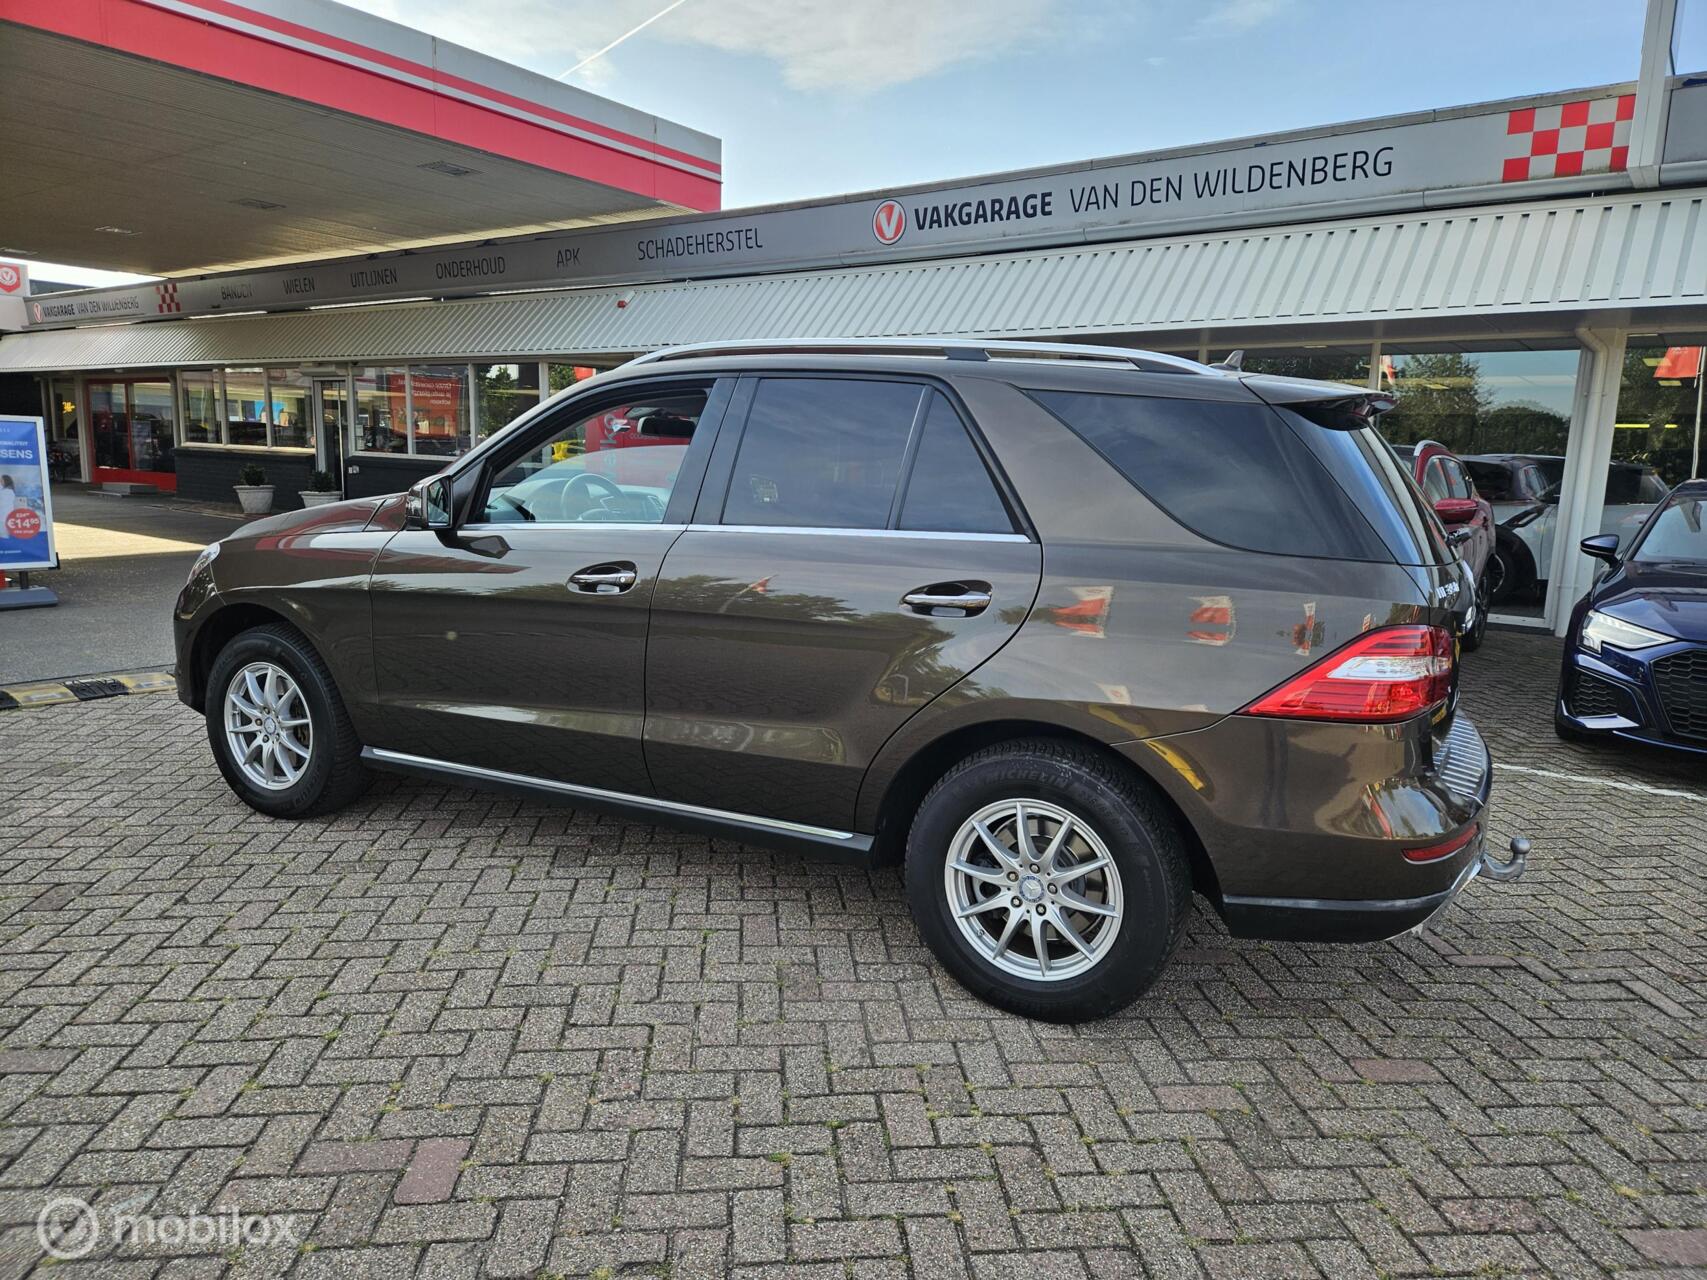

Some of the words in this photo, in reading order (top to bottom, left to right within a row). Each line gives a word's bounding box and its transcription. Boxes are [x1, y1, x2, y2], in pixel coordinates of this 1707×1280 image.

[914, 191, 1054, 230] VAKGARAGE
[1069, 183, 1119, 213] VAN
[1129, 173, 1184, 206] DEN
[1193, 146, 1394, 200] WILDENBERG
[637, 227, 764, 261] SCHADEHERSTEL
[435, 256, 506, 280] ONDERHOUD
[556, 247, 581, 268] APK
[283, 277, 315, 295] WIELEN
[42, 303, 76, 318] VAKGARAGE
[77, 302, 88, 314] VAN
[89, 300, 100, 313] DEN
[102, 296, 139, 311] WILDENBERG
[983, 768, 1067, 788] MICHELIN
